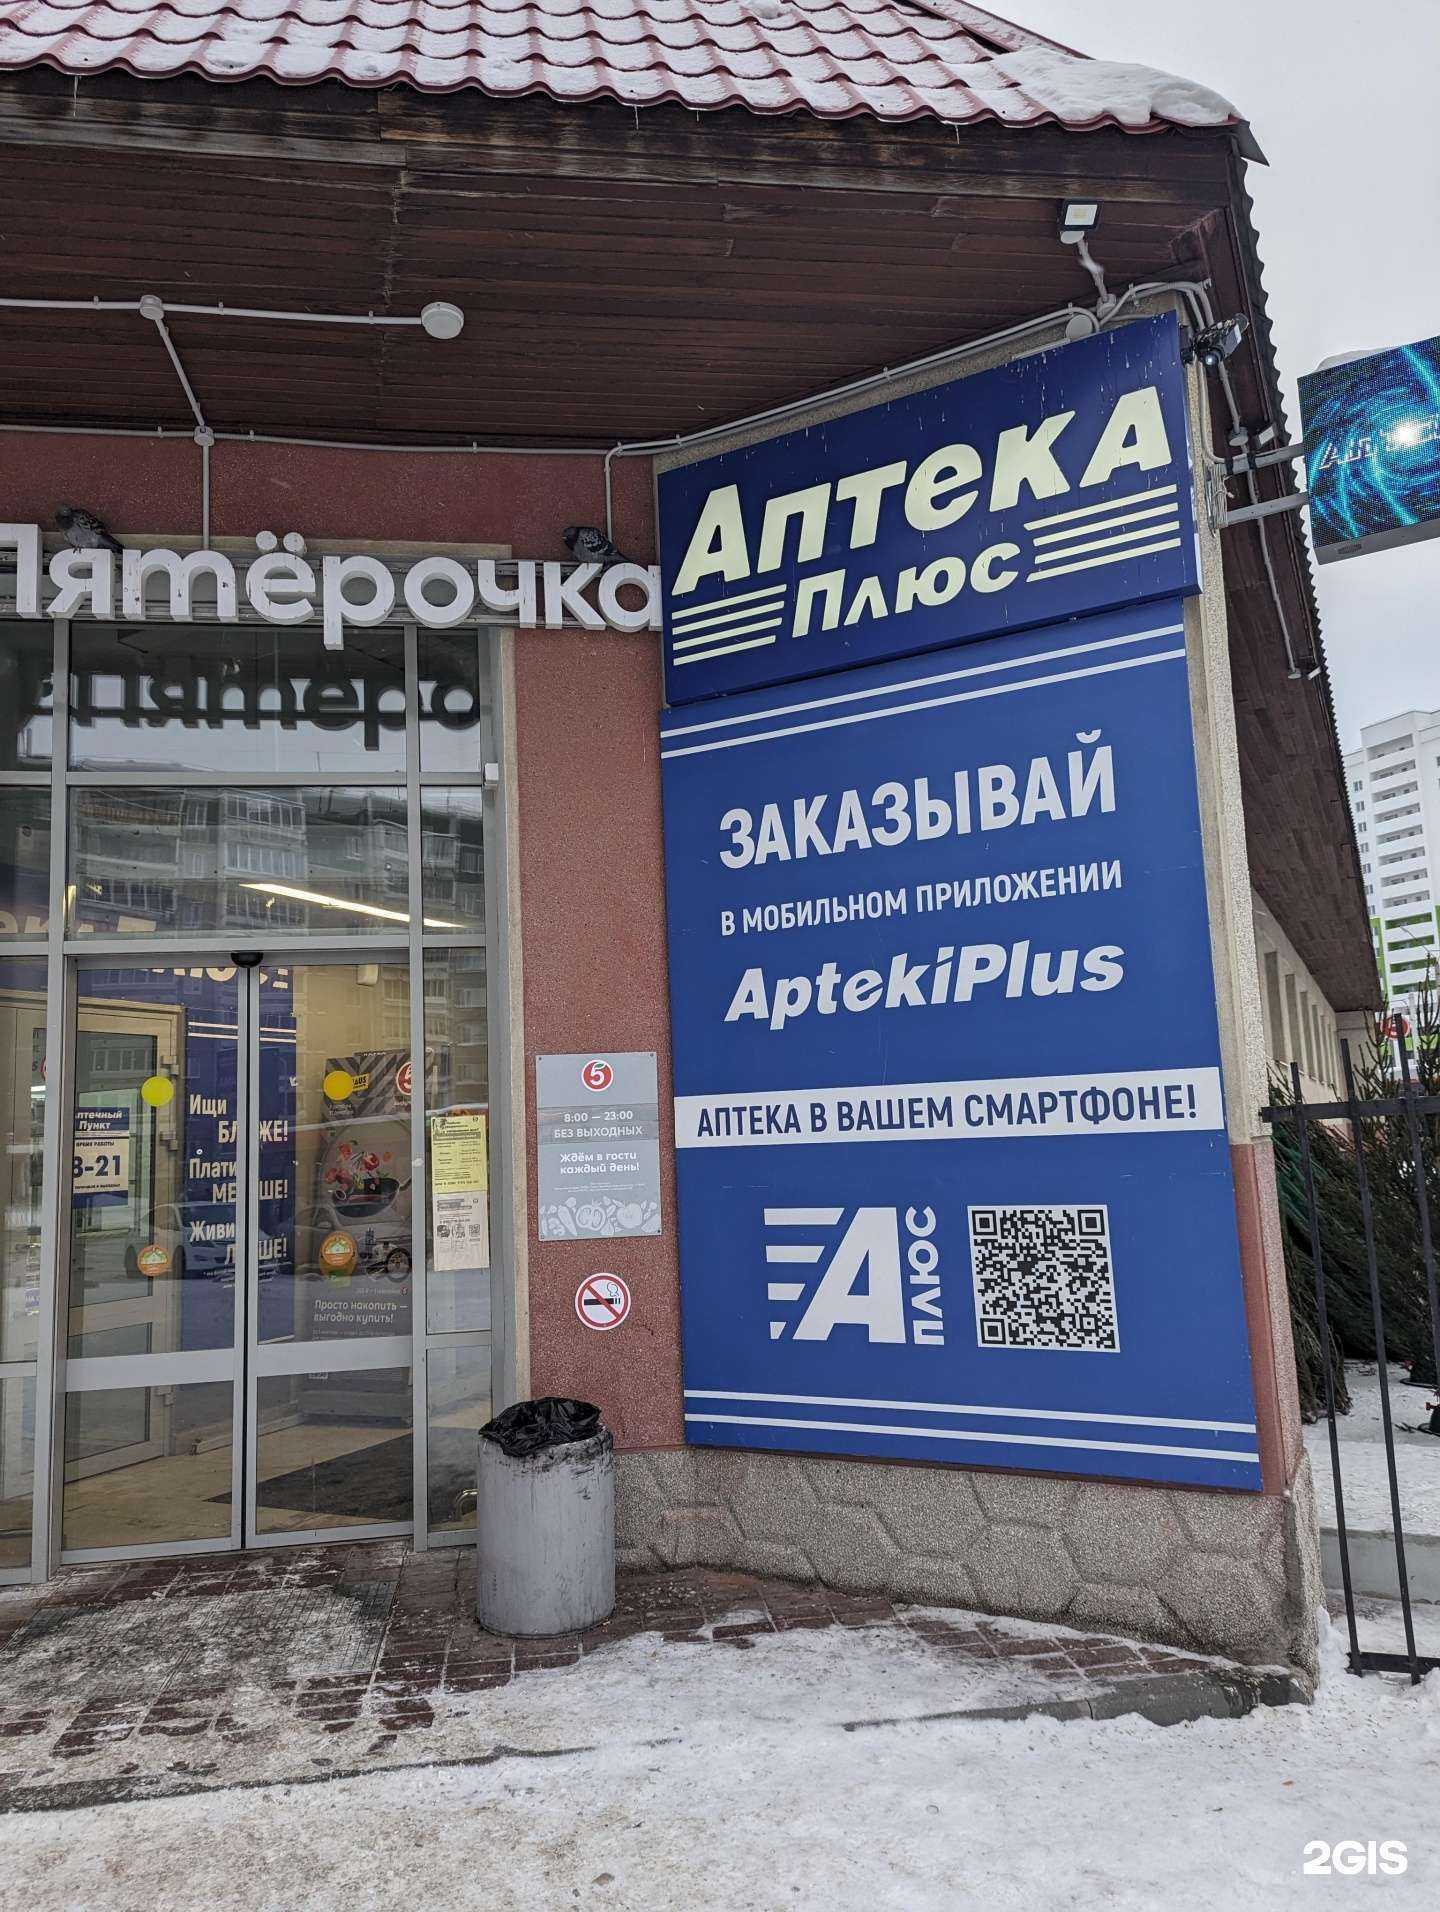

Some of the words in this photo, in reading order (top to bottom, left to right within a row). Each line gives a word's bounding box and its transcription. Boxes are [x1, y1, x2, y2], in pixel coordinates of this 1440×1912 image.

[719, 729, 1117, 869] ЗАКАЗЫВАЙ
[721, 910, 736, 936] В
[743, 888, 907, 934] МОБИЛЬНОМ
[917, 860, 1122, 913] ПРИЛОЖЕНИИ
[724, 939, 1126, 1031] AptekiPlus
[189, 1094, 227, 1117] Ищи
[697, 1104, 802, 1138] АПТЕКА
[810, 1102, 828, 1133] В
[837, 1097, 955, 1133] ВАШЕМ
[964, 1083, 1198, 1128] СМАРТФОНЕ!
[75, 1110, 123, 1120] птечный
[564, 1112, 588, 1122] 8:00
[604, 1110, 633, 1120] 23:00
[79, 1120, 111, 1131] Пункт
[218, 1120, 288, 1143] БЛЖЕ!
[554, 1128, 574, 1138] БЕЗ
[576, 1126, 643, 1138] ВЫХОДНЫХ
[560, 1152, 593, 1162] Ждём
[606, 1152, 637, 1161] гости
[560, 1163, 606, 1174] каждый
[609, 1162, 640, 1172] день!
[212, 1179, 288, 1203] МЕШЕ!
[190, 1220, 236, 1242] Живи
[314, 1300, 349, 1311] Просто
[351, 1301, 397, 1310] накопить
[313, 1311, 354, 1322] выгодно
[356, 1313, 394, 1325] купить!
